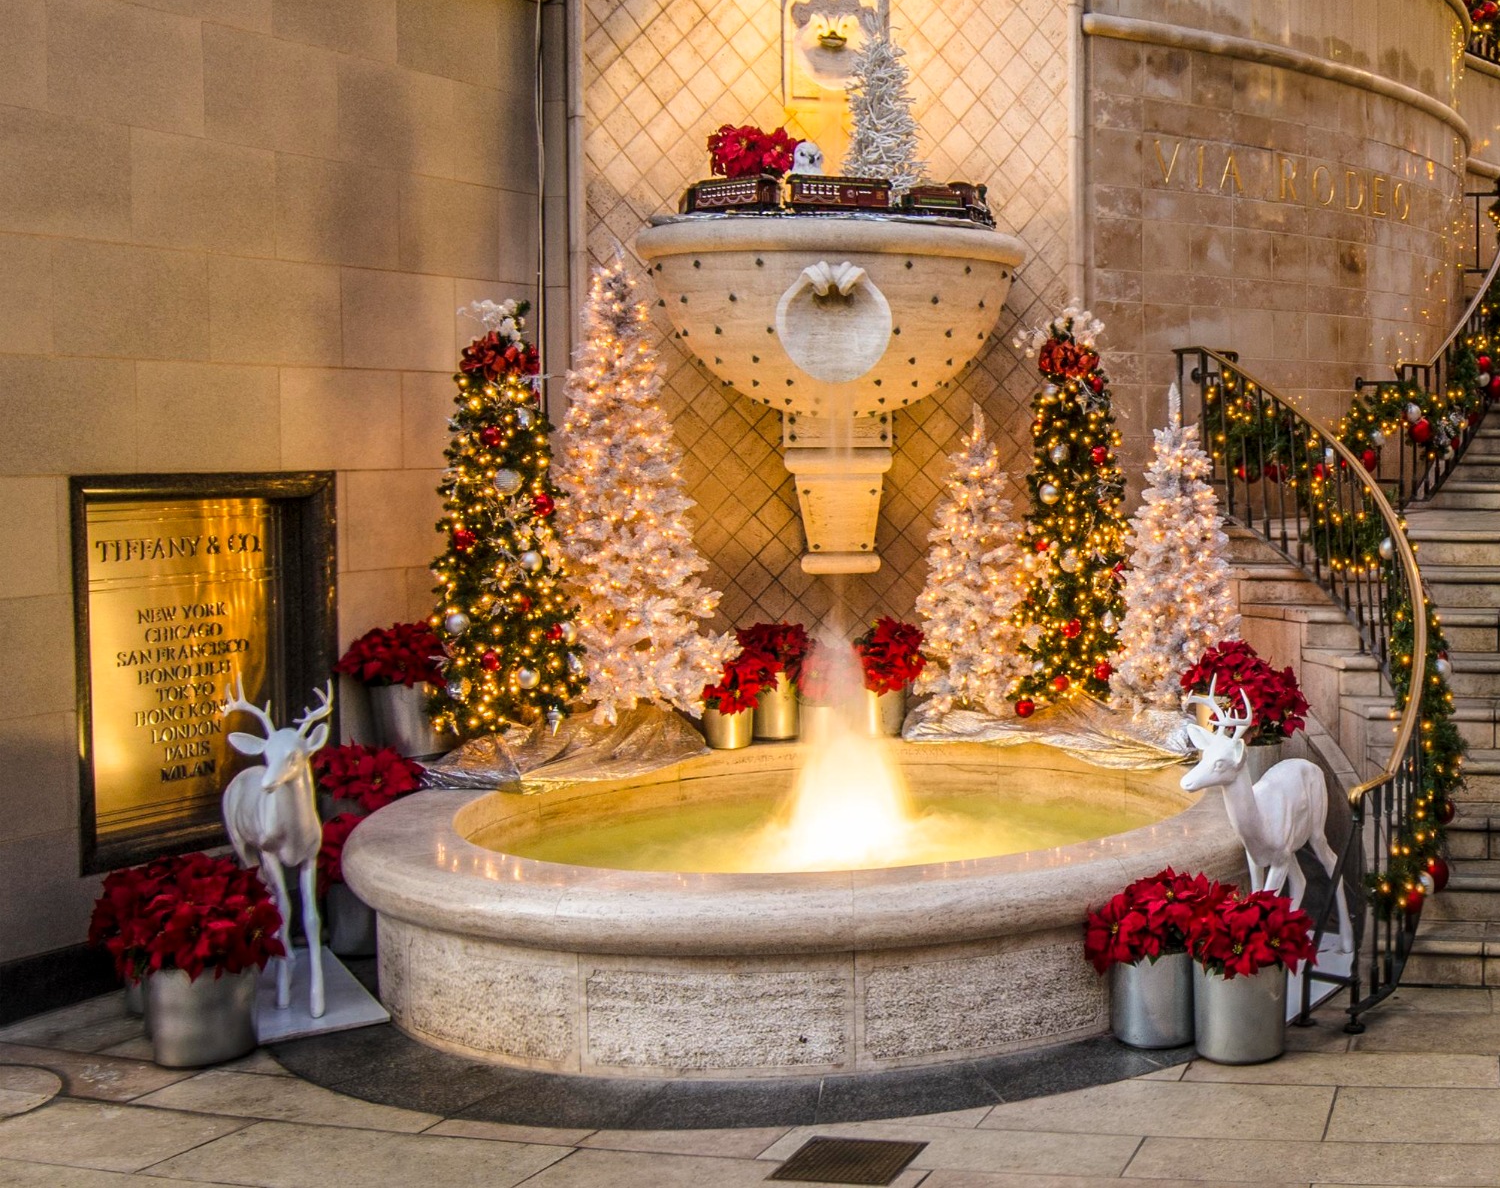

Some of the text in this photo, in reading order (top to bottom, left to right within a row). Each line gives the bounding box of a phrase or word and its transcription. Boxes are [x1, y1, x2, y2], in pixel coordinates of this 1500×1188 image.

[1154, 140, 1410, 220] VIA RODEO
[95, 536, 202, 562] TIFFANY
[206, 534, 221, 554] &
[136, 602, 227, 624] NEW YORK
[144, 622, 223, 643] CHICAGO
[117, 639, 249, 667] SAN FRANCISCO
[137, 659, 231, 685] HONOLULU
[155, 681, 215, 702] TOKYO
[135, 705, 184, 727] HONG
[151, 719, 221, 744] LONDON
[164, 740, 210, 762] PARIS
[161, 759, 216, 783] MILAN
